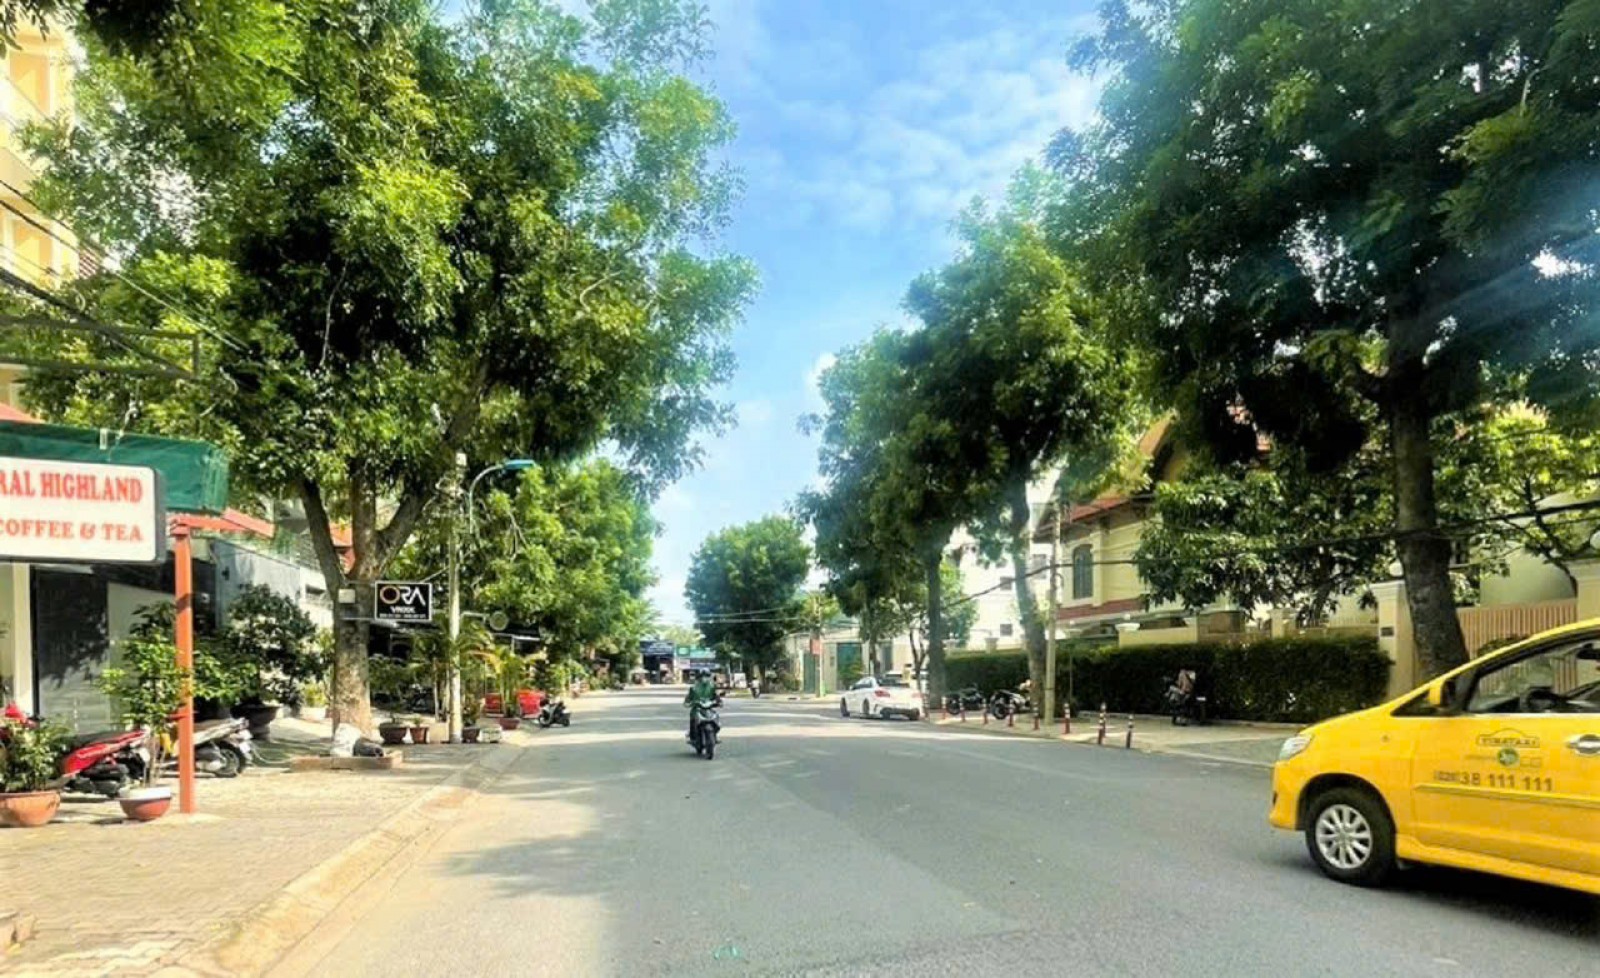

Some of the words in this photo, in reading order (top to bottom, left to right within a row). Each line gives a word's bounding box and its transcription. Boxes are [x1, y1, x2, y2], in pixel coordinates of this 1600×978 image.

[40, 472, 144, 504] HIGHLAND
[80, 524, 96, 541] &
[101, 523, 143, 542] TEA
[1488, 773, 1516, 788] 111
[1522, 776, 1552, 791] 111
